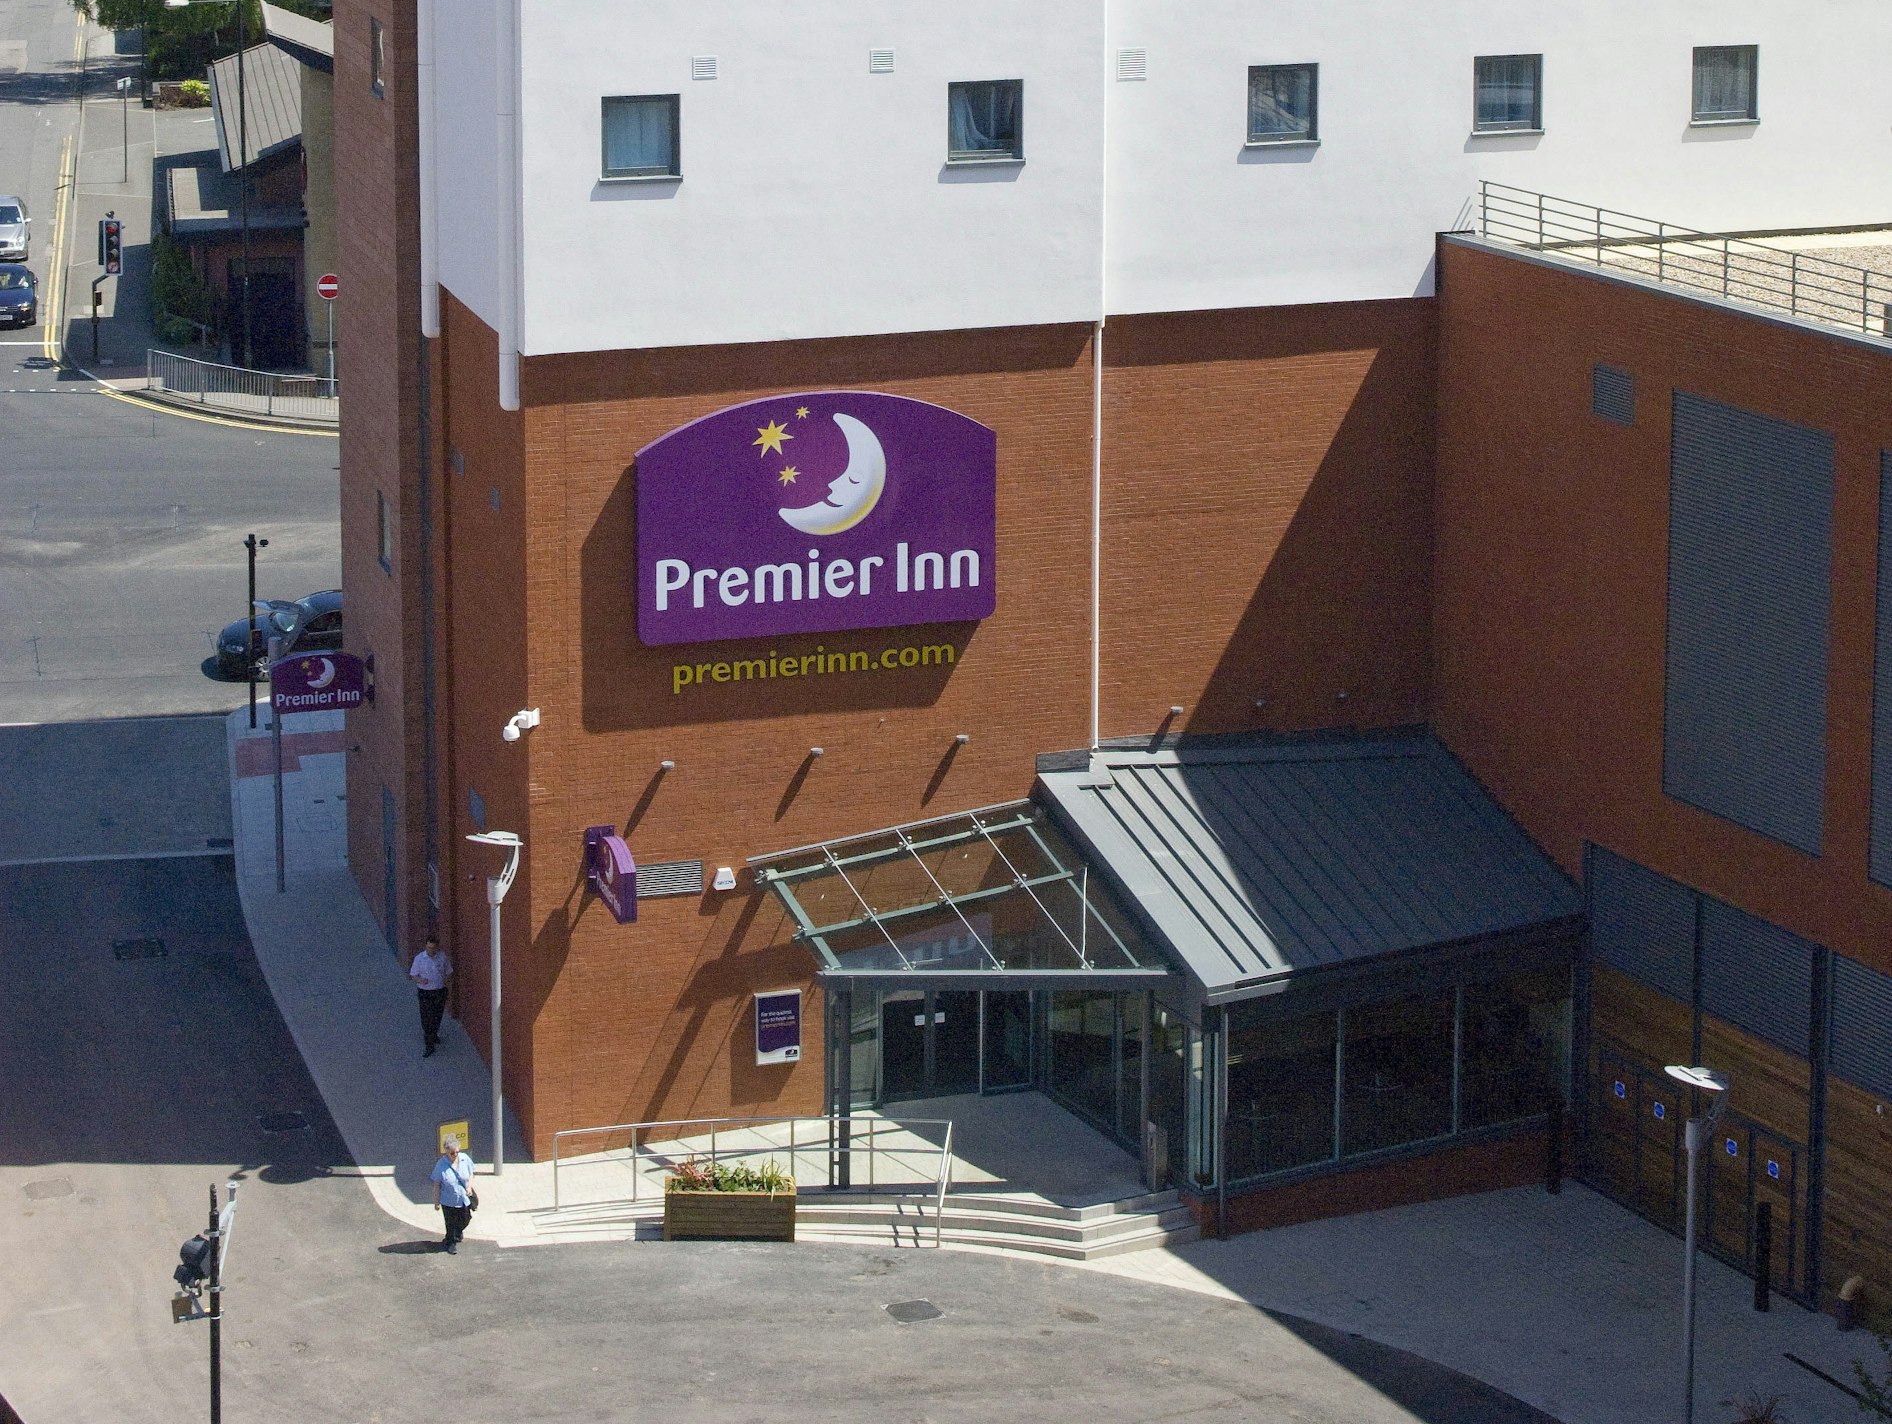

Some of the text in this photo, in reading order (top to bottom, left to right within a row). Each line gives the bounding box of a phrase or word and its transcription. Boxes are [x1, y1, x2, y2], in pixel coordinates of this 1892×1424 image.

[655, 542, 981, 612] Premier Inn
[672, 641, 956, 695] premierinn.com
[275, 688, 360, 707] Premier Inn
